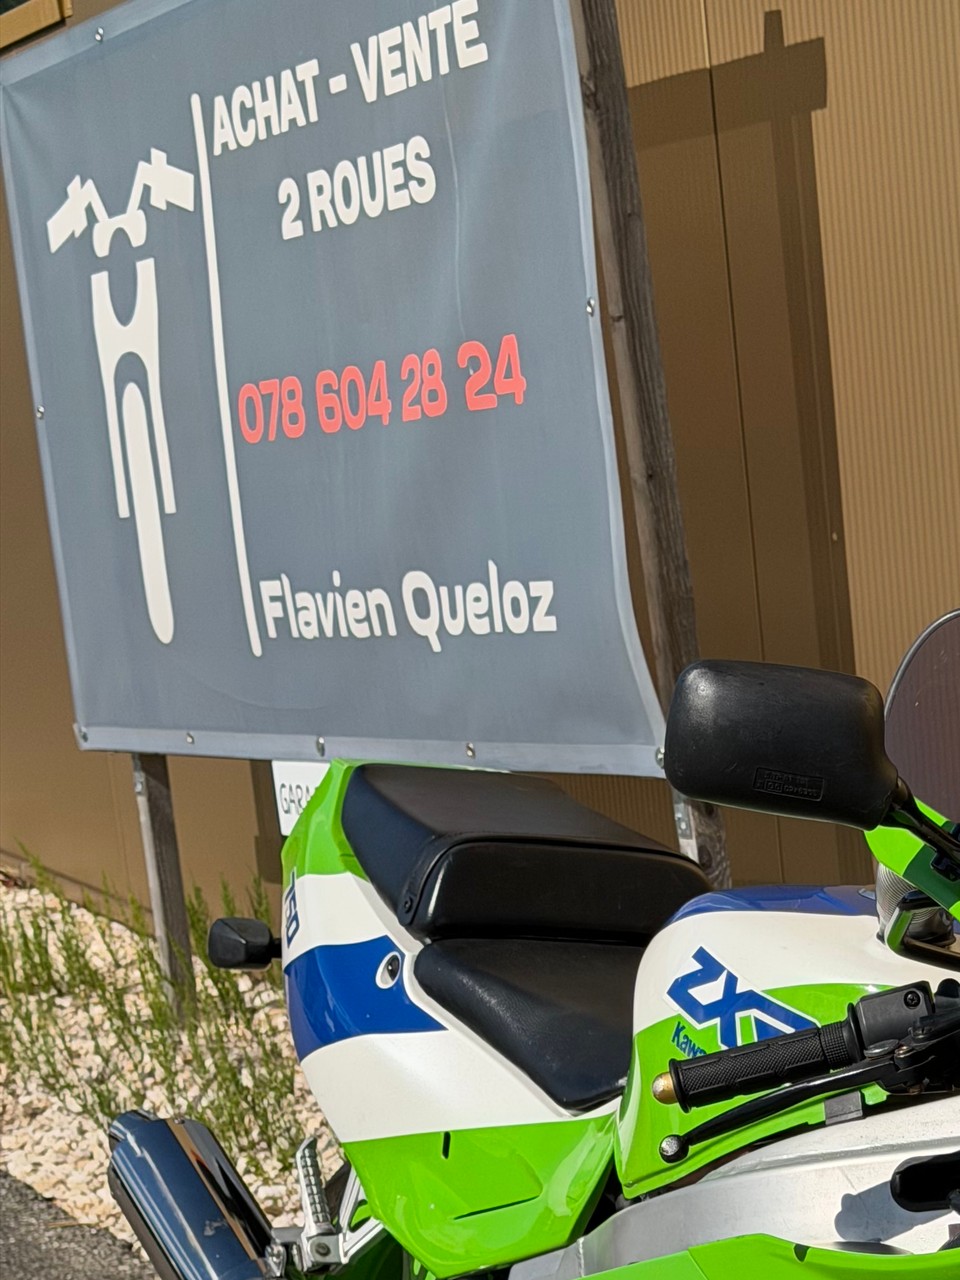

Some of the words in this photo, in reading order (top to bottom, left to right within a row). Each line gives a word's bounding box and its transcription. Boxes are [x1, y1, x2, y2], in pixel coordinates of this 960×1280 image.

[213, 58, 320, 156] ACHAT
[350, 0, 489, 103] VENTE
[278, 177, 304, 241] 2
[306, 135, 436, 232] ROUES
[238, 376, 305, 444] 078
[315, 360, 391, 434] 604
[400, 348, 448, 422] 28
[457, 334, 526, 412] 24
[259, 570, 397, 641] Flavien
[402, 560, 557, 653] Queloz
